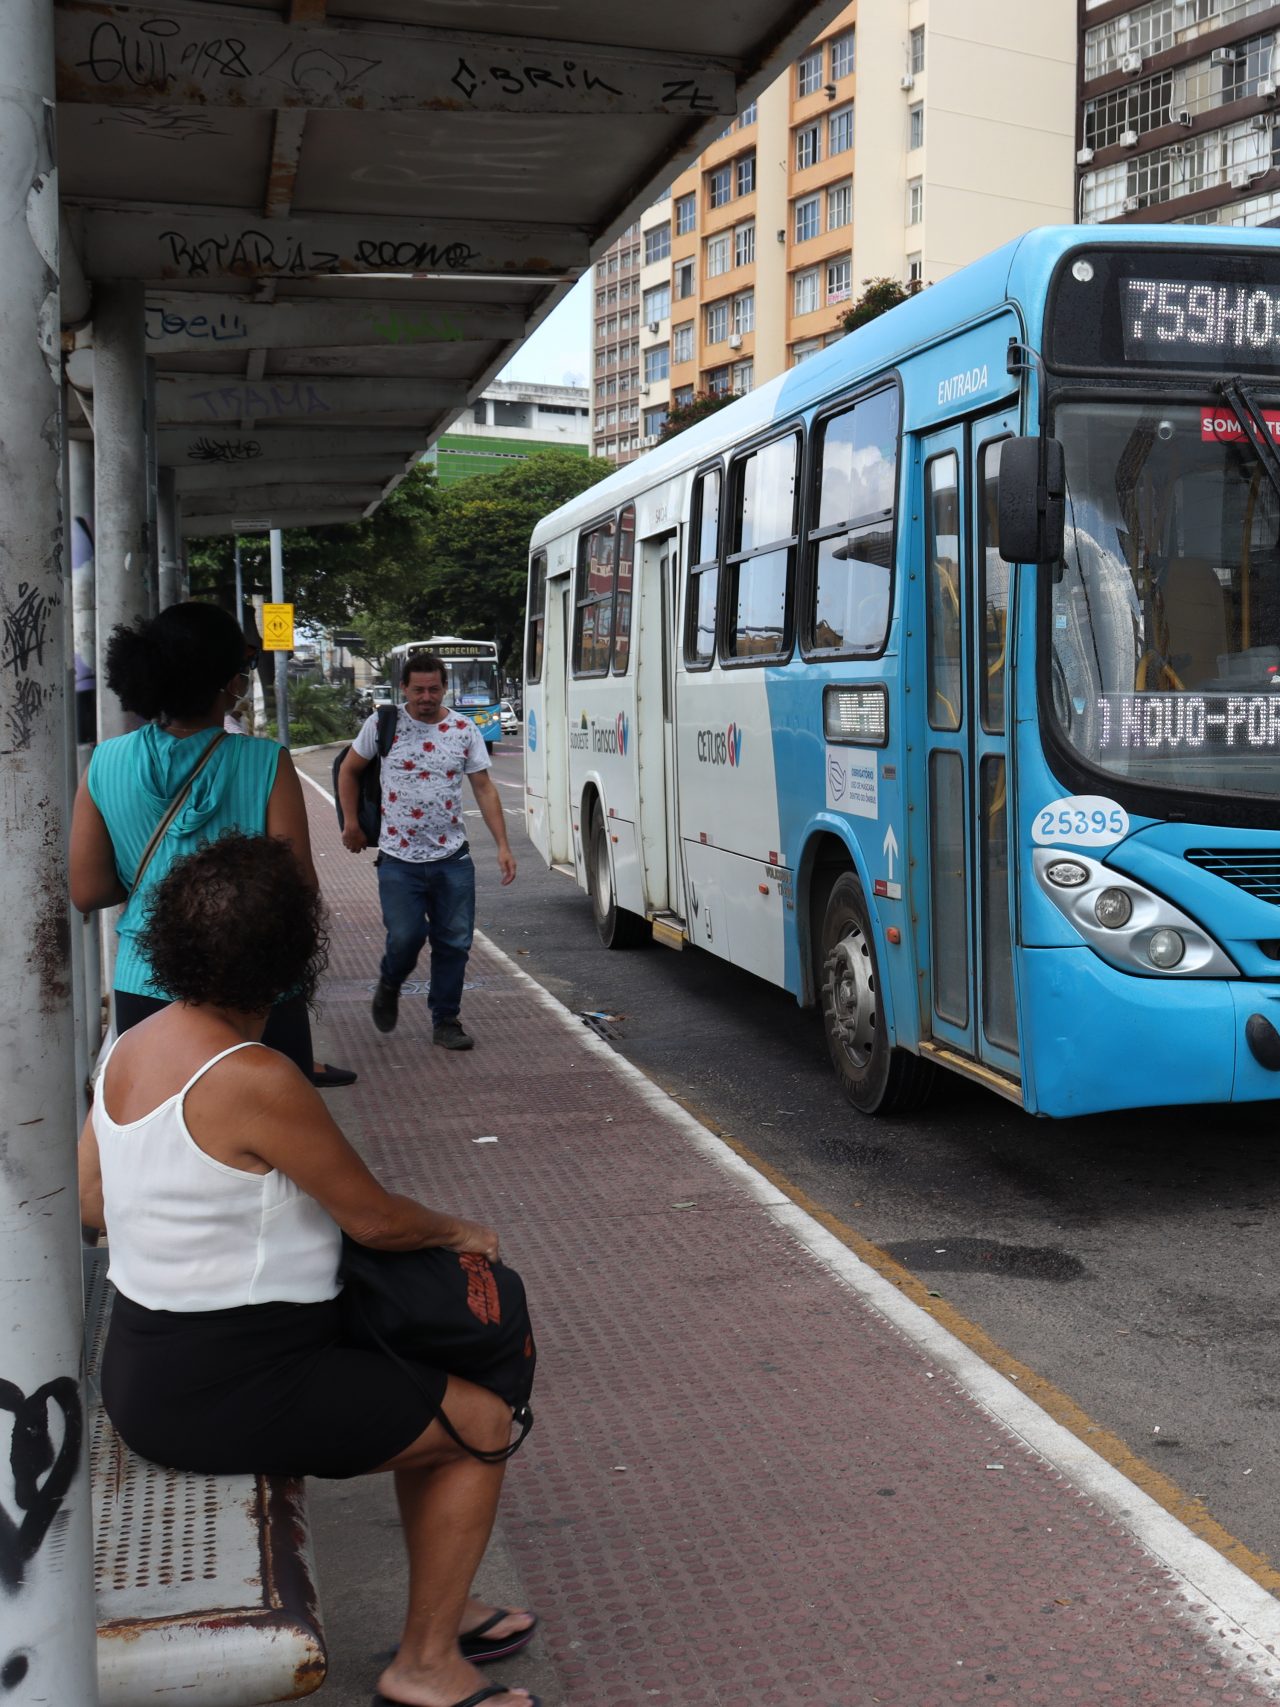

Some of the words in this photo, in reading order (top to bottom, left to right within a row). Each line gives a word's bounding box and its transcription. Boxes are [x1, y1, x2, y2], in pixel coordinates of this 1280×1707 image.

[937, 364, 989, 406] ENTRADA
[438, 646, 481, 655] ESPECIAL
[1040, 809, 1124, 836] 25395
